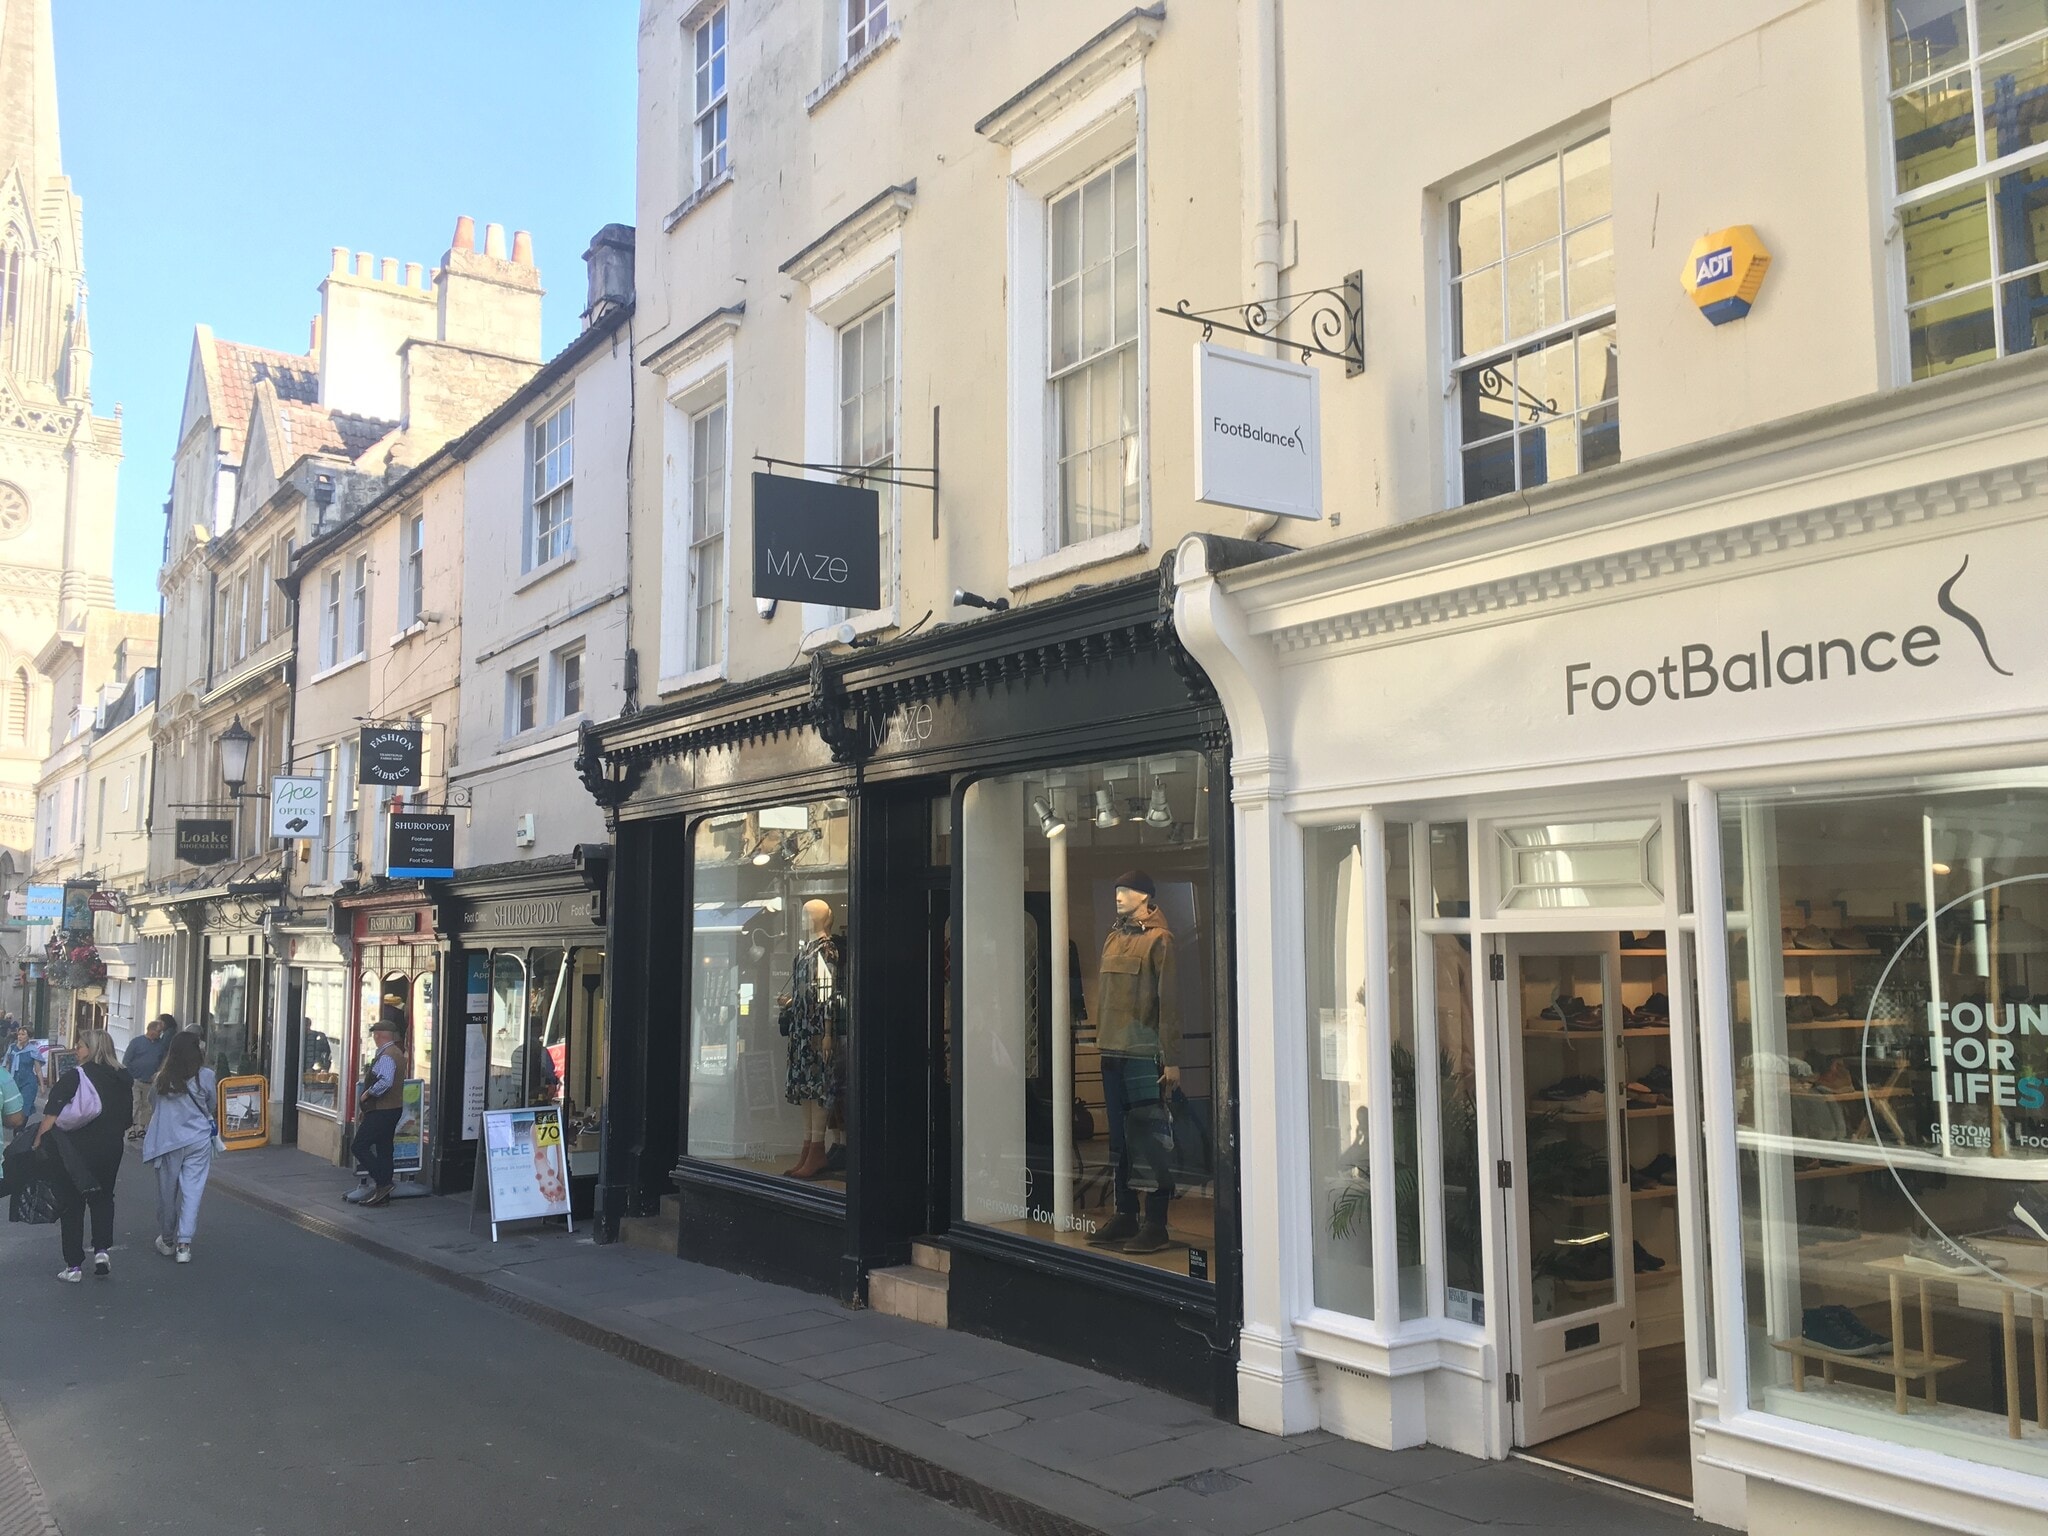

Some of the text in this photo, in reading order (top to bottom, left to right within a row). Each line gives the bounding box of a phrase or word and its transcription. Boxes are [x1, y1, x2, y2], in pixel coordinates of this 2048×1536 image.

[1696, 250, 1733, 284] ADT
[1213, 416, 1296, 448] FootBalance
[1565, 623, 1941, 716] FootBalance
[370, 733, 415, 751] FASHION
[371, 765, 410, 780] FABRICS
[276, 781, 319, 804] Ace
[278, 807, 316, 816] OPTICS
[394, 821, 451, 832] SHUROPODY
[180, 830, 229, 843] Loake
[464, 912, 475, 923] Foot
[494, 901, 562, 927] SHUROPODY
[570, 904, 585, 917] Foot
[1929, 1036, 2016, 1071] FOR
[1931, 1071, 2048, 1109] LIFES
[538, 1114, 558, 1123] SALE
[490, 1143, 530, 1157] FREE
